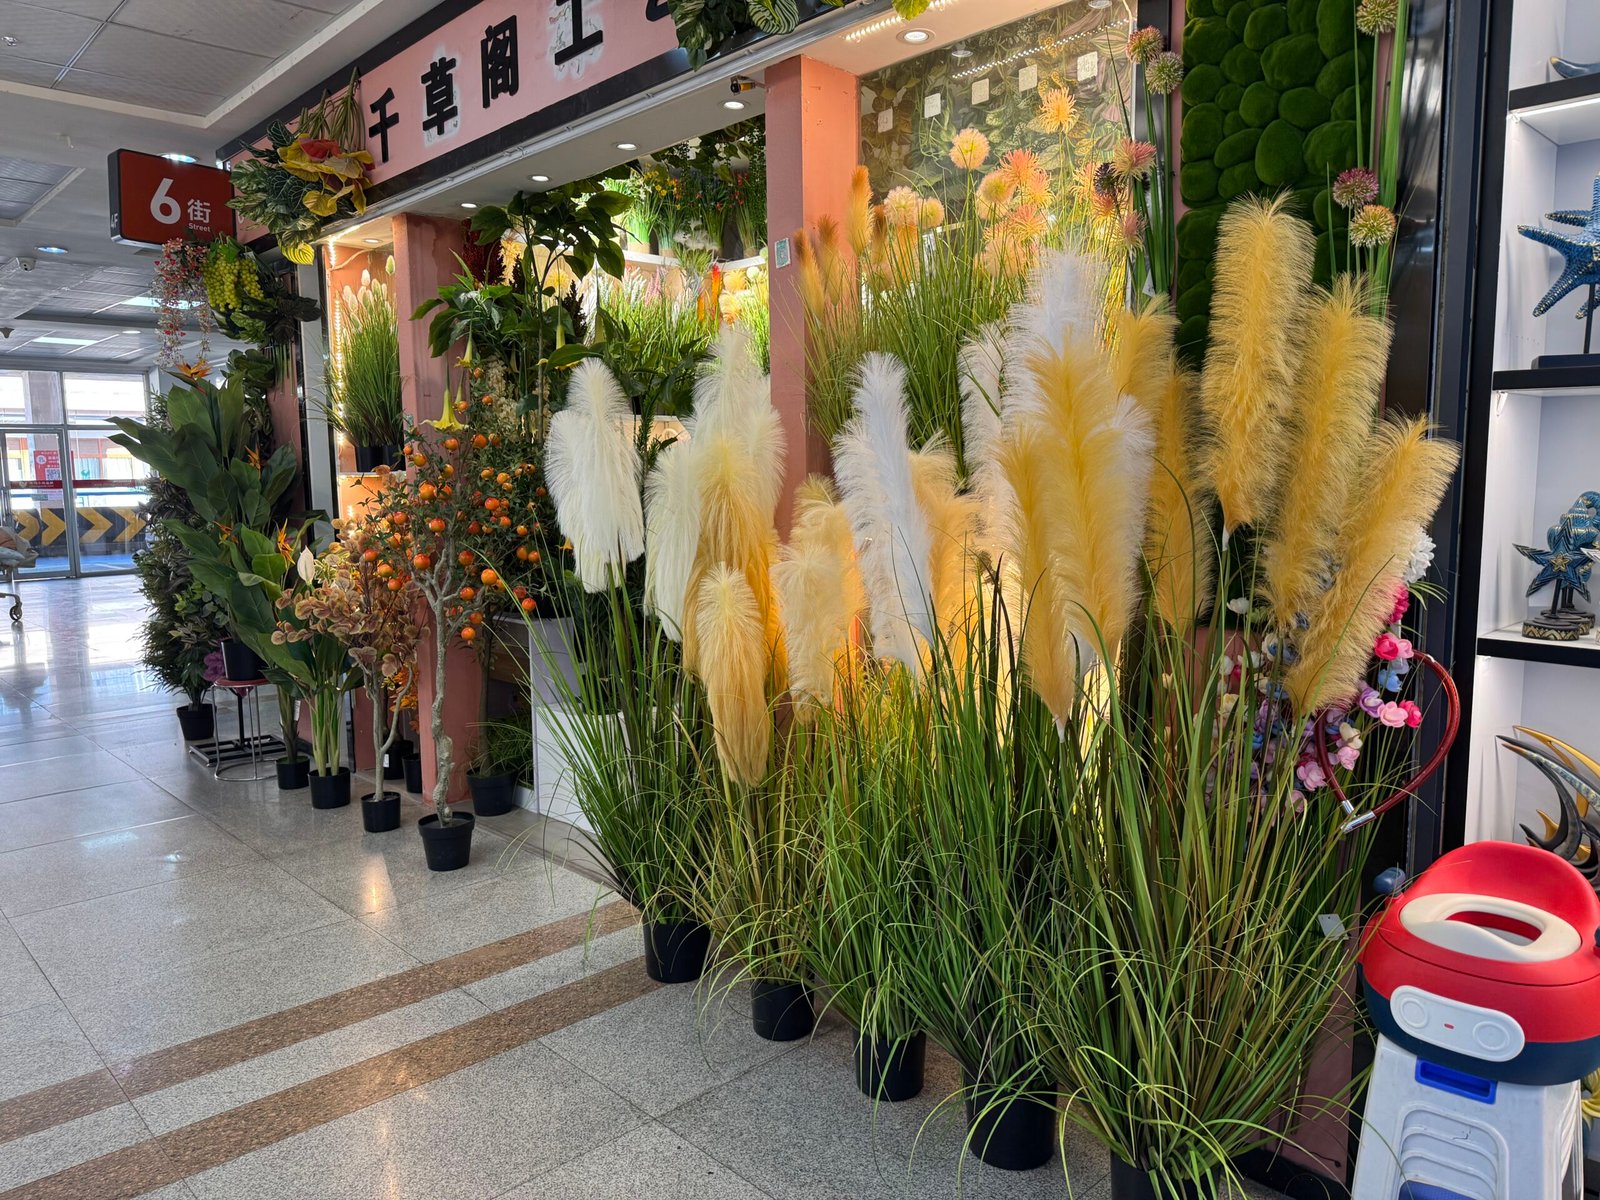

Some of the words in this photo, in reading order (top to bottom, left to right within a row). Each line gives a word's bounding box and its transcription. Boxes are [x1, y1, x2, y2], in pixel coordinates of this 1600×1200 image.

[369, 0, 670, 163] 千草阁工
[188, 222, 211, 232] Street
